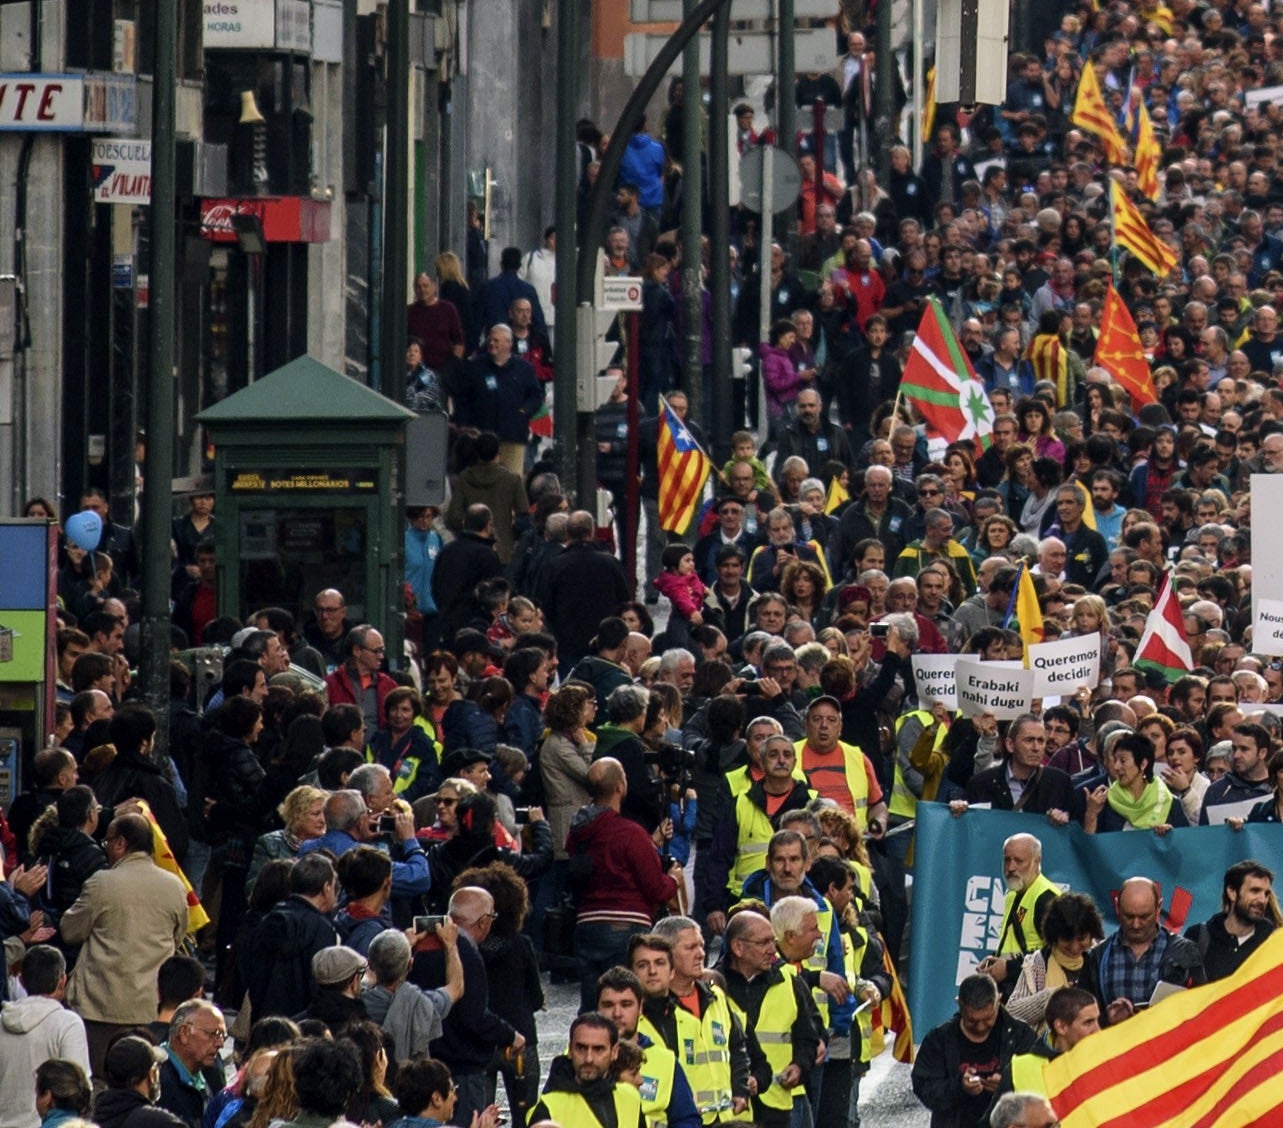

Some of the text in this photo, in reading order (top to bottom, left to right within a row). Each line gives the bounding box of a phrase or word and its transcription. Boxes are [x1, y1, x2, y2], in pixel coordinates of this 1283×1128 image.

[203, 2, 238, 15] ades
[207, 23, 241, 33] HORAS
[0, 84, 62, 120] TE
[1034, 649, 1098, 669] Queremos
[968, 675, 1020, 693] Erabaki
[1047, 668, 1092, 683] decidir
[962, 690, 1025, 709] nahi dugu
